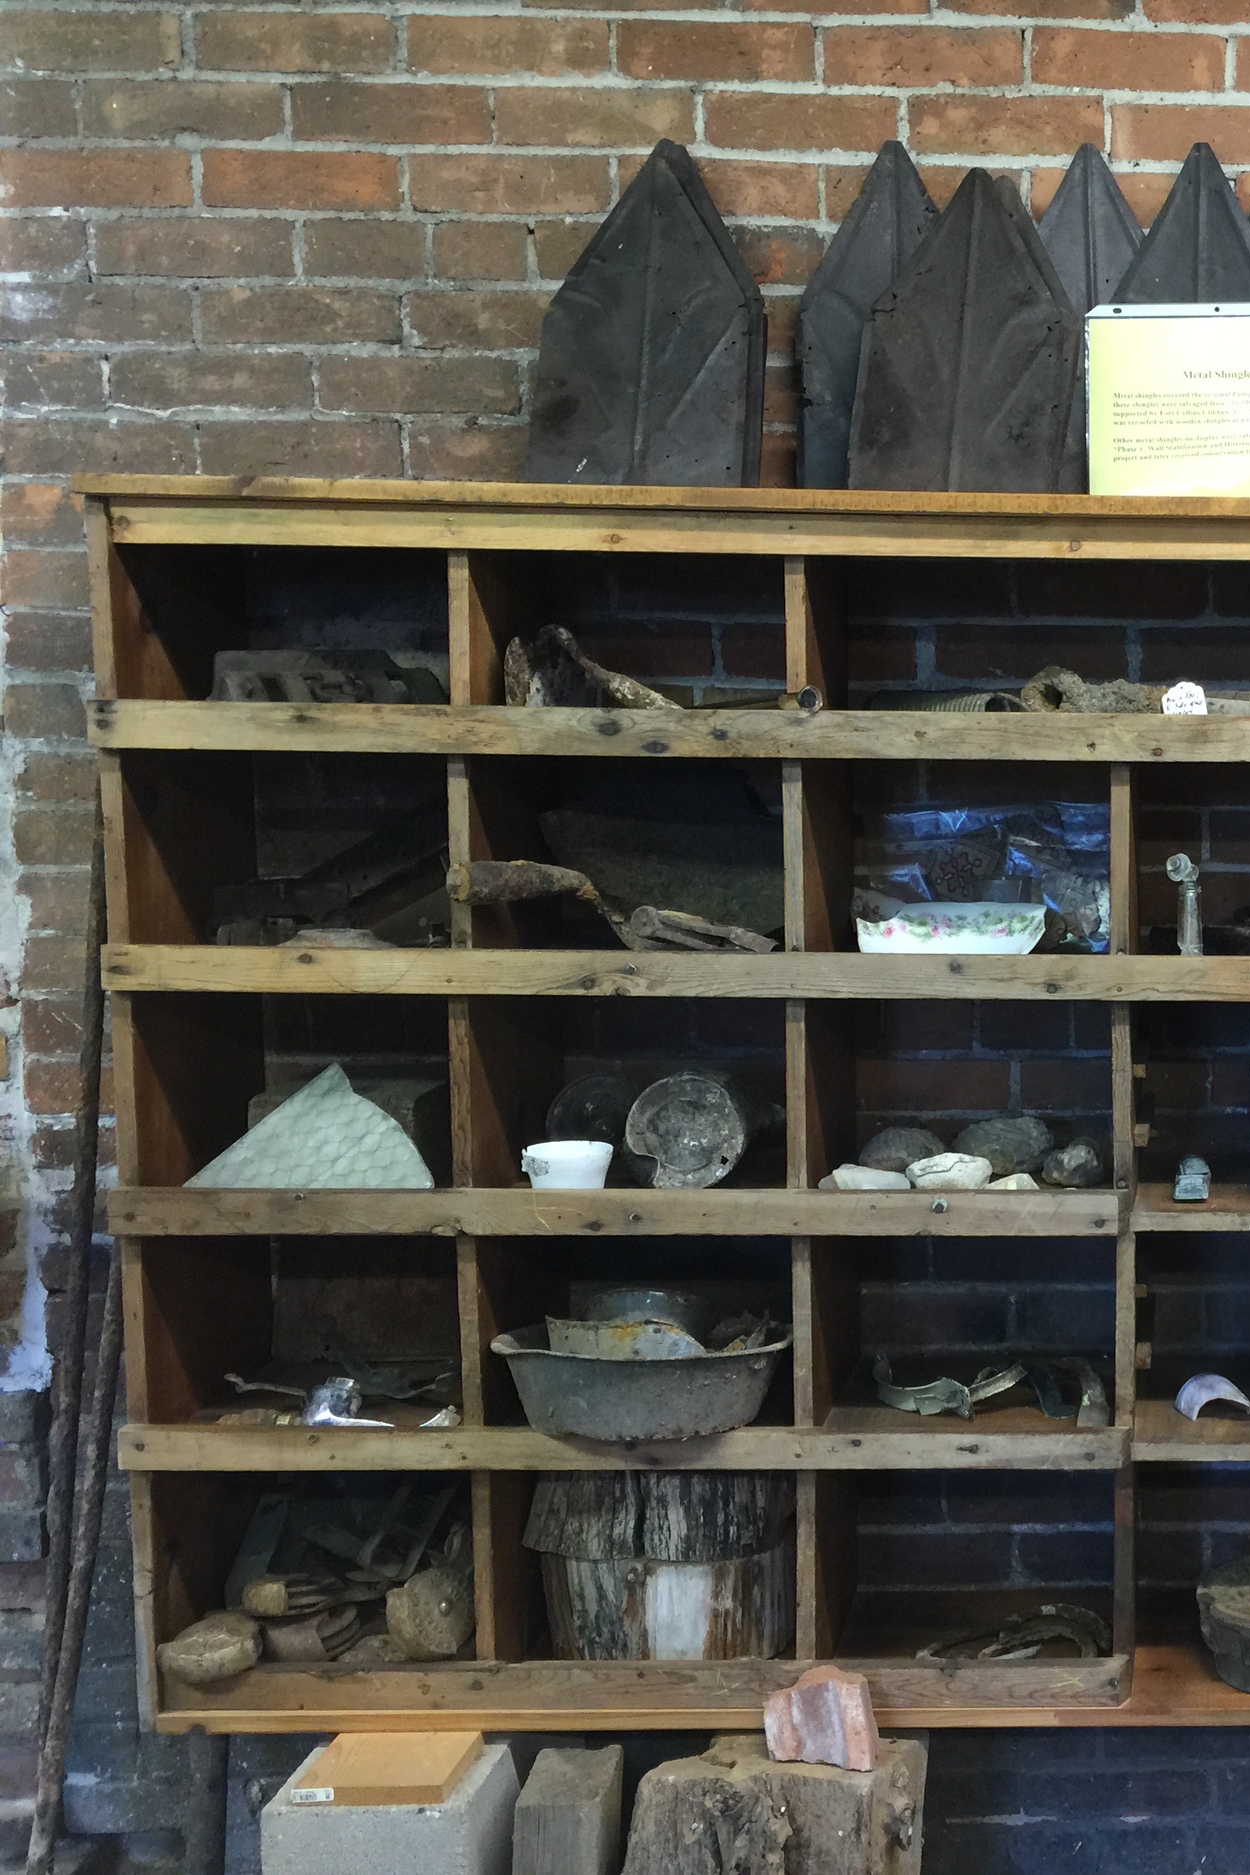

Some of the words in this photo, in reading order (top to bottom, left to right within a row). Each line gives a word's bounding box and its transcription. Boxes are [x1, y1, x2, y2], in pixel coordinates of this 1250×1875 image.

[1183, 370, 1212, 379] Metal
[1134, 392, 1162, 400] shingles
[1163, 391, 1190, 399] covered
[1132, 401, 1160, 409] shingles
[1179, 400, 1208, 408] salvaged
[1113, 410, 1149, 418] supported
[1203, 416, 1231, 425] shingles
[1113, 436, 1133, 444] Other
[1156, 435, 1183, 443] shingles
[1194, 434, 1219, 442] display
[1113, 454, 1138, 463] project
[1171, 451, 1200, 459] received
[1200, 449, 1244, 457] conservation
